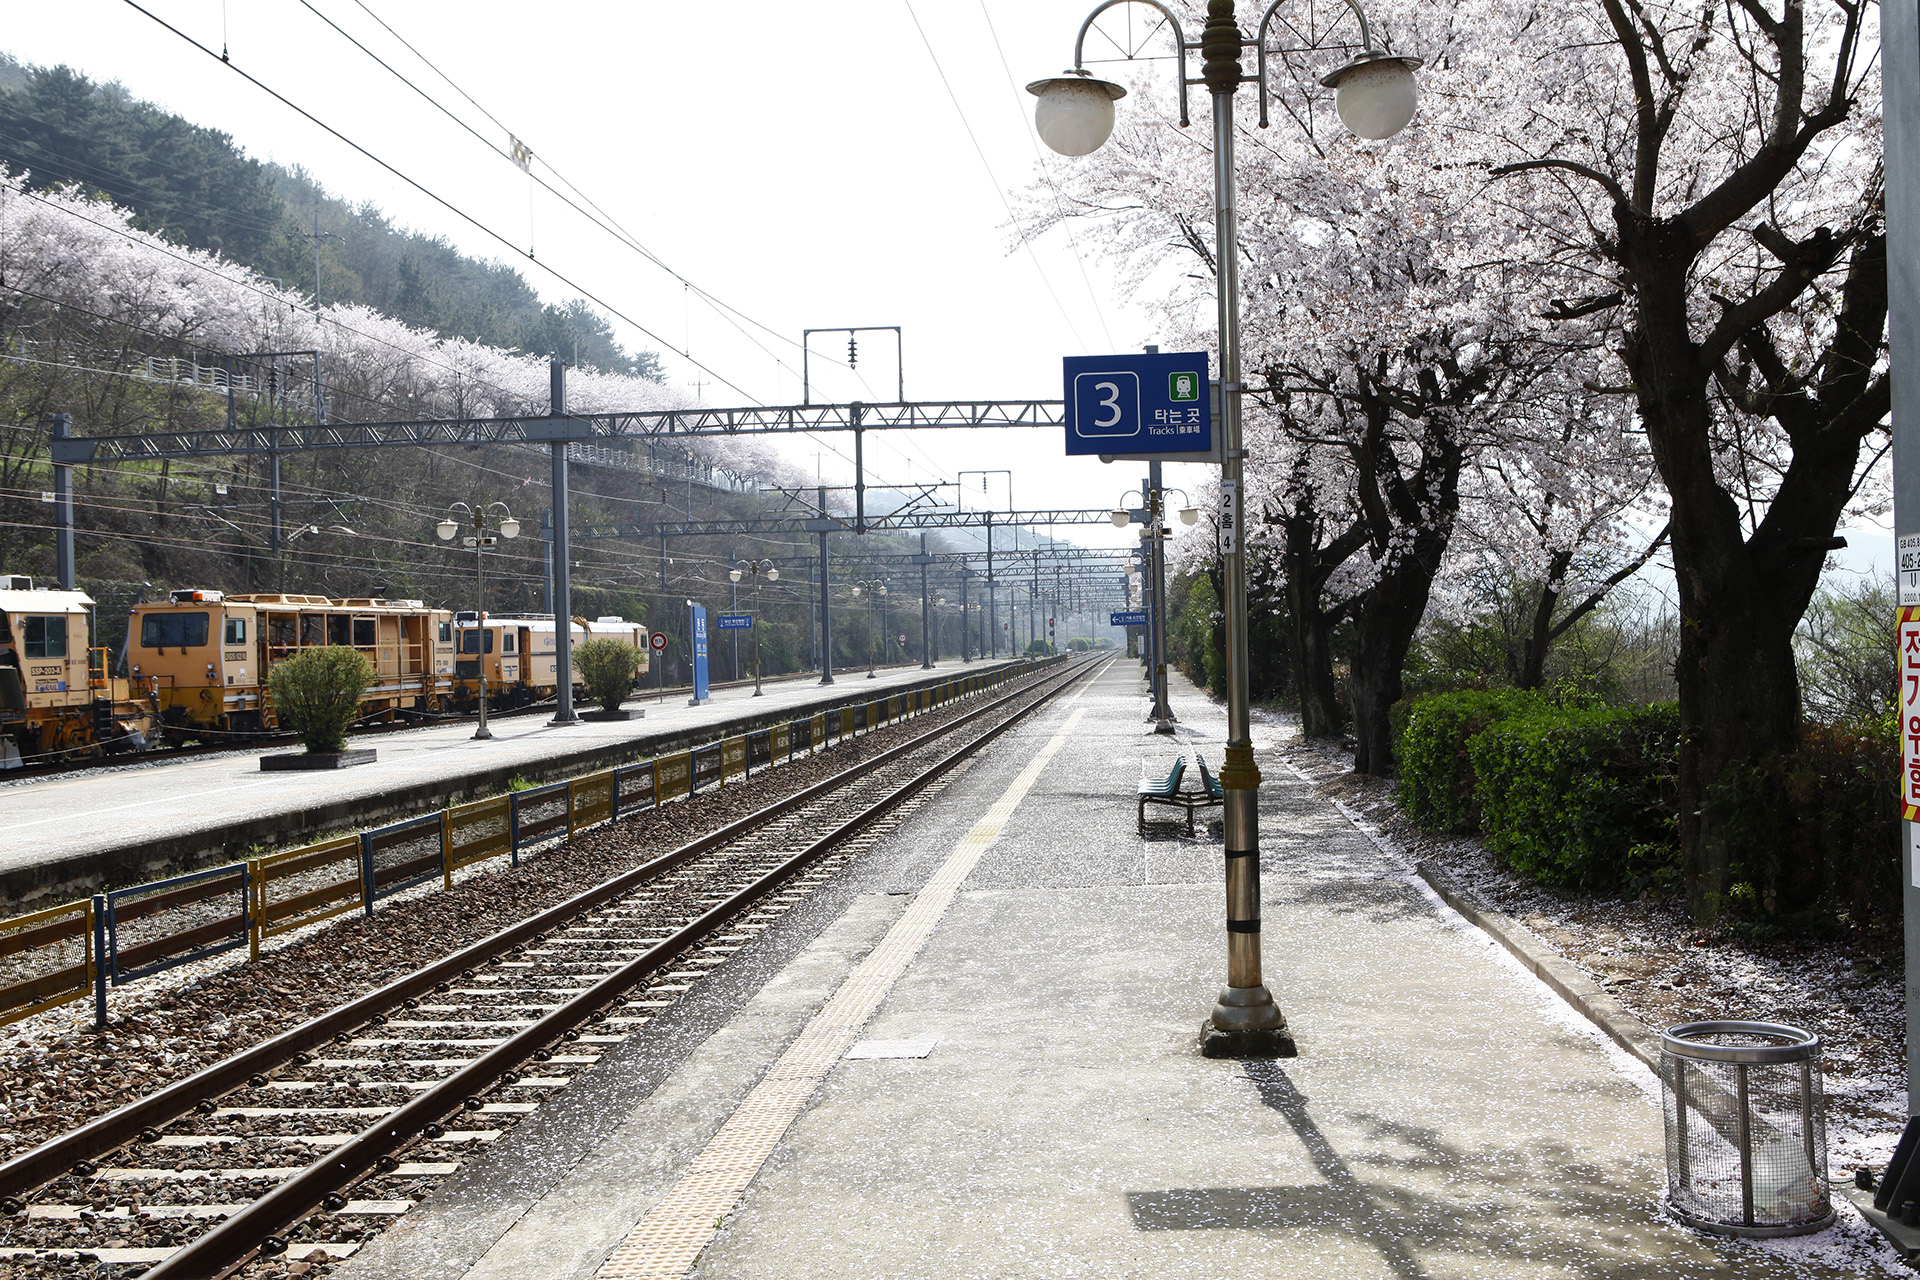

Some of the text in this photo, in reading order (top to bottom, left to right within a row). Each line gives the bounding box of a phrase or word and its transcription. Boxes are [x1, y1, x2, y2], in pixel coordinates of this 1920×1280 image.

[1094, 382, 1122, 427] 3
[1155, 408, 1200, 424] 타는 곳
[1148, 426, 1175, 435] Tracks
[31, 666, 62, 676] SSP-203-K
